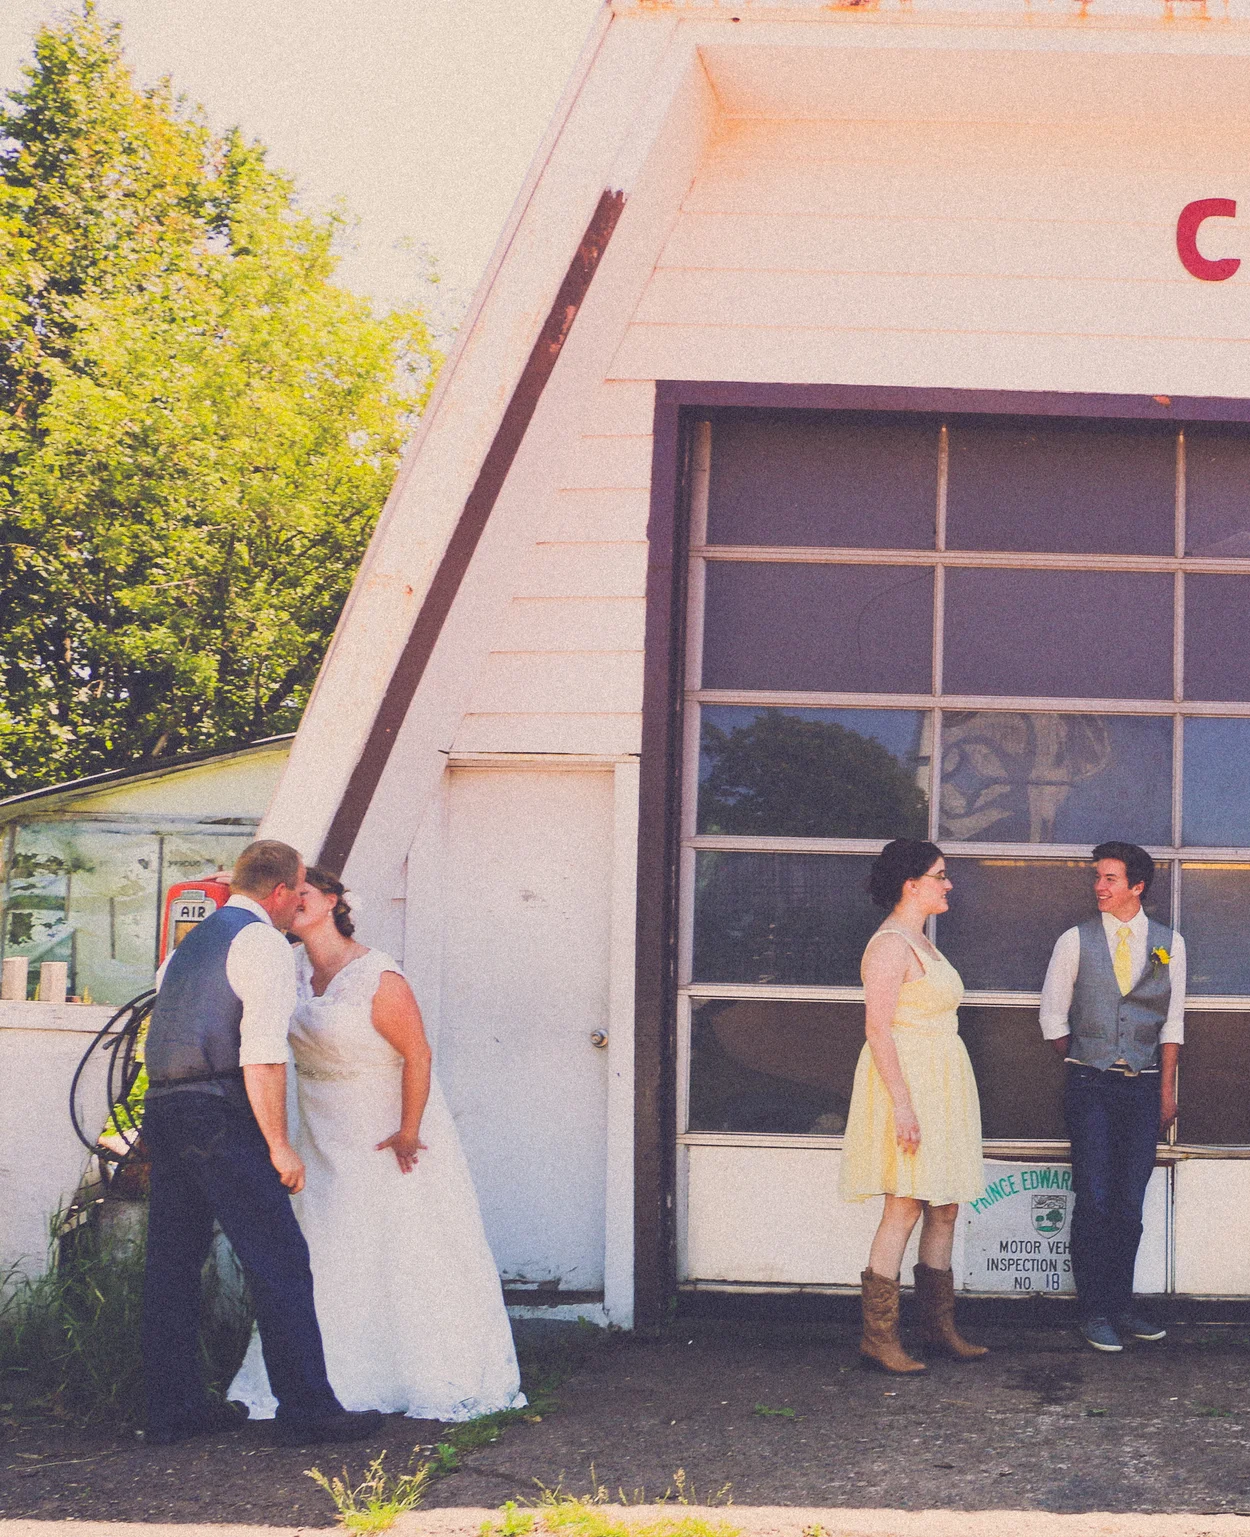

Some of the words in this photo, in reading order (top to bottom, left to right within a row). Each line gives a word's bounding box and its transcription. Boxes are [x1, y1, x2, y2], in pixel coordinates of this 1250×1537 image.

[181, 906, 206, 918] AIR
[969, 1175, 1020, 1215] PRINCE
[1020, 1169, 1073, 1192] EDWAR
[999, 1240, 1042, 1254] MOTOR
[1047, 1241, 1071, 1255] VEH
[986, 1257, 1058, 1272] INSPECTION
[1013, 1276, 1034, 1290] NO.
[1045, 1272, 1060, 1291] 18
